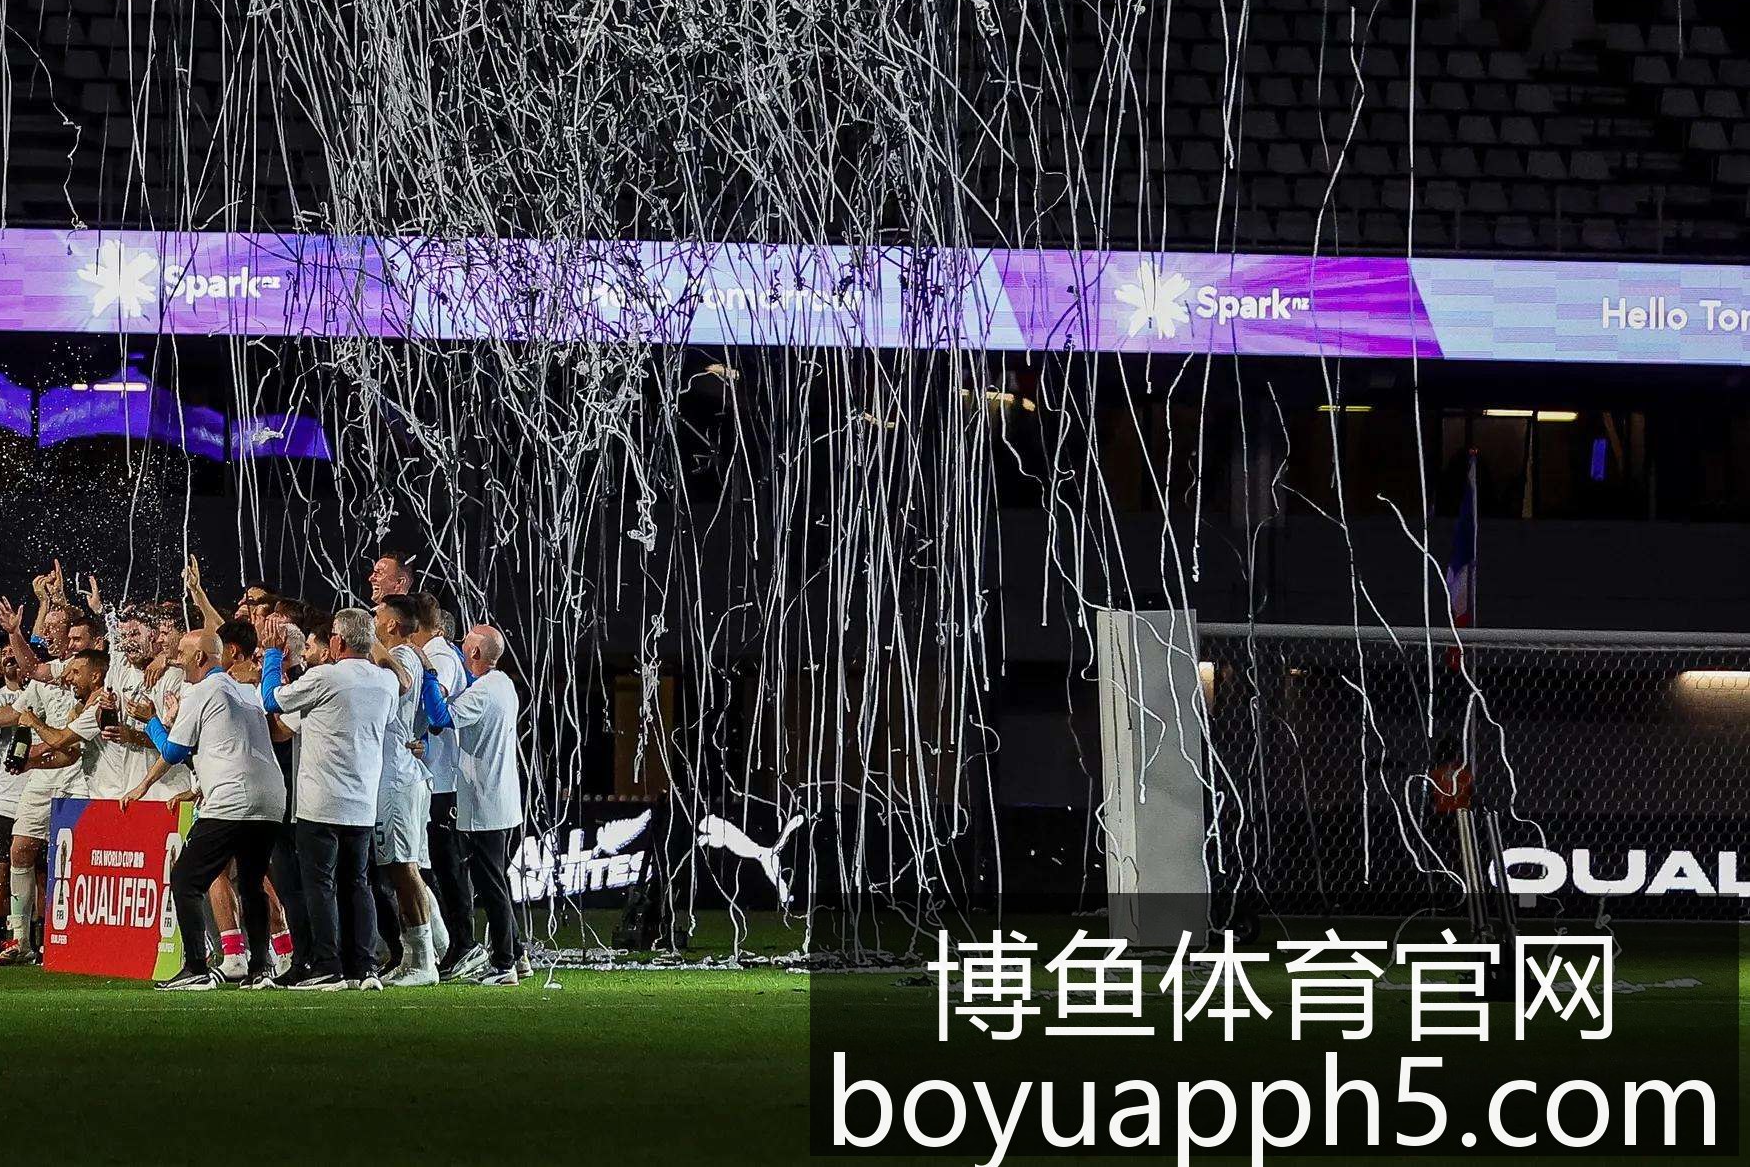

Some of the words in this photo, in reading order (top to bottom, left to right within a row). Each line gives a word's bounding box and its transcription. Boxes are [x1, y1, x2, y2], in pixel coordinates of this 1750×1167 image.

[164, 265, 261, 305] Spark
[1196, 285, 1291, 325] Spark
[1602, 296, 1688, 331] Hello
[73, 874, 158, 928] QUALIFIED
